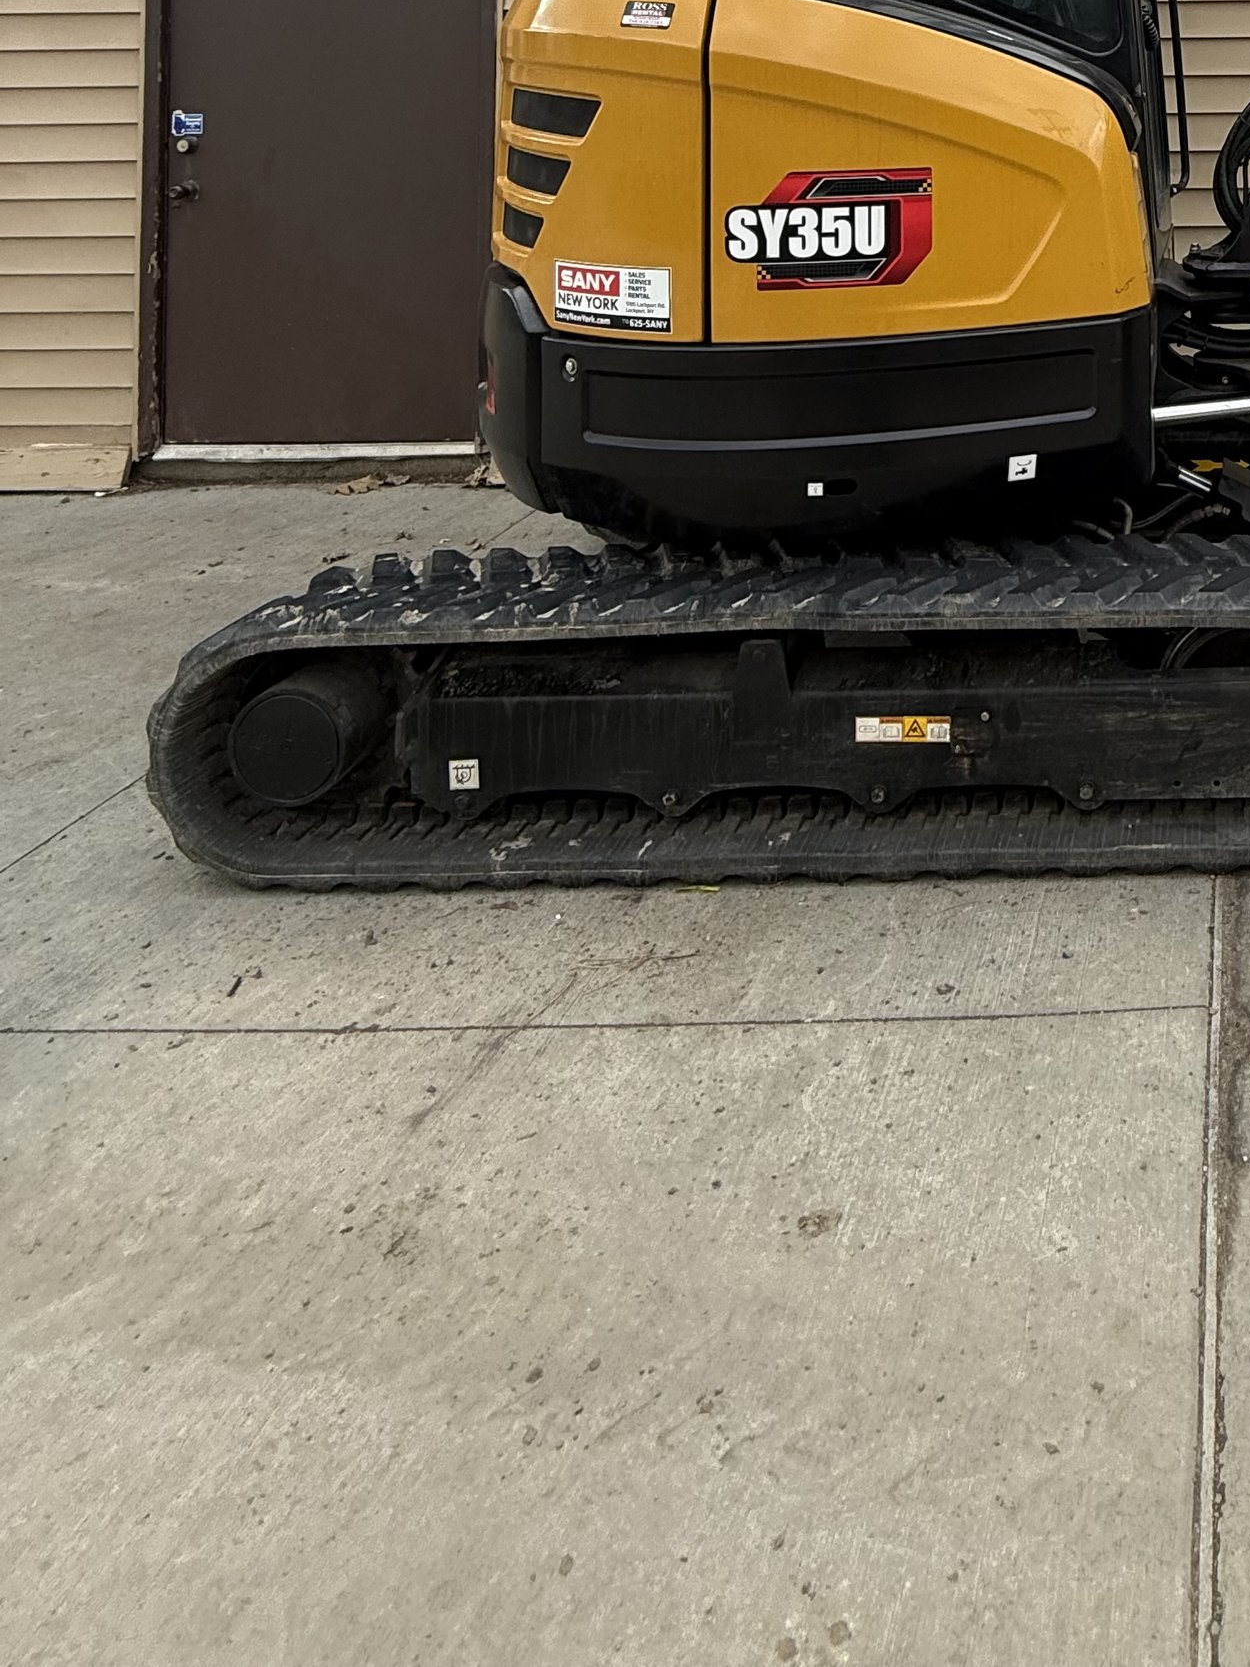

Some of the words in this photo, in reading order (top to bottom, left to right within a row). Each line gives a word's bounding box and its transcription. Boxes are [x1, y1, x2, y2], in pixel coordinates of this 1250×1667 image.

[632, 2, 668, 11] ROSS
[728, 205, 886, 260] SY35U
[561, 270, 615, 292] SANY
[558, 292, 582, 307] NEW
[586, 296, 619, 311] YORK
